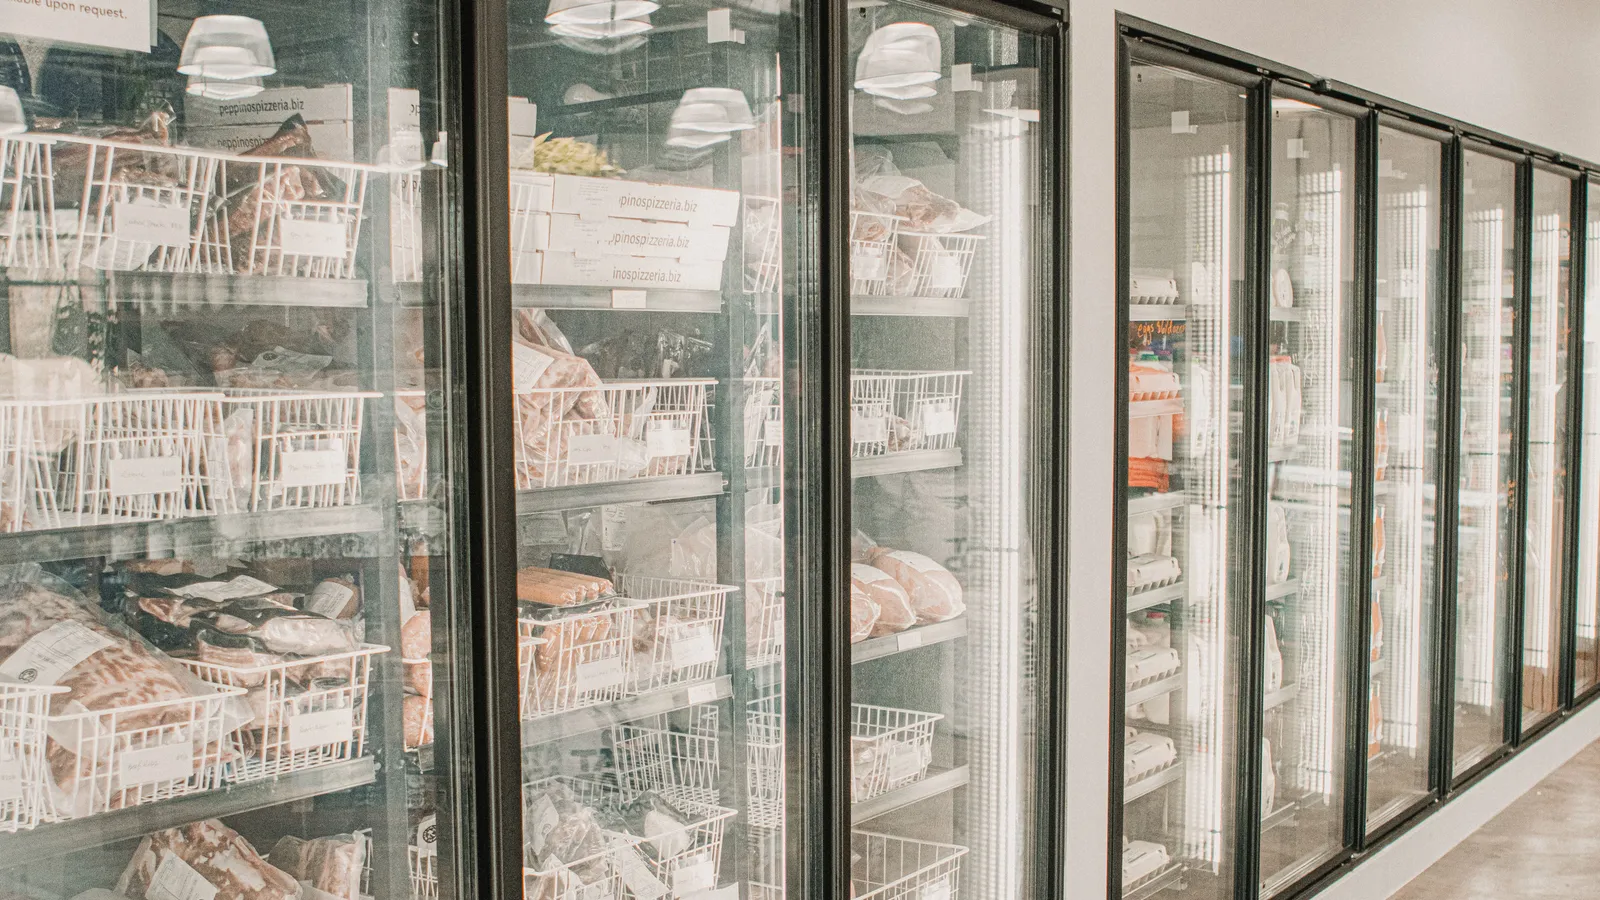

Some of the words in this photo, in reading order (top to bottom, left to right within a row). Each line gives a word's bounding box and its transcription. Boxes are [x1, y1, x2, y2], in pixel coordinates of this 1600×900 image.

[45, 0, 76, 12] upon
[79, 4, 128, 19] request.
[219, 98, 305, 117] peppinospizzeria.biz
[618, 193, 698, 212] pinospizzeria.biz
[612, 265, 682, 282] inospizzeria.biz
